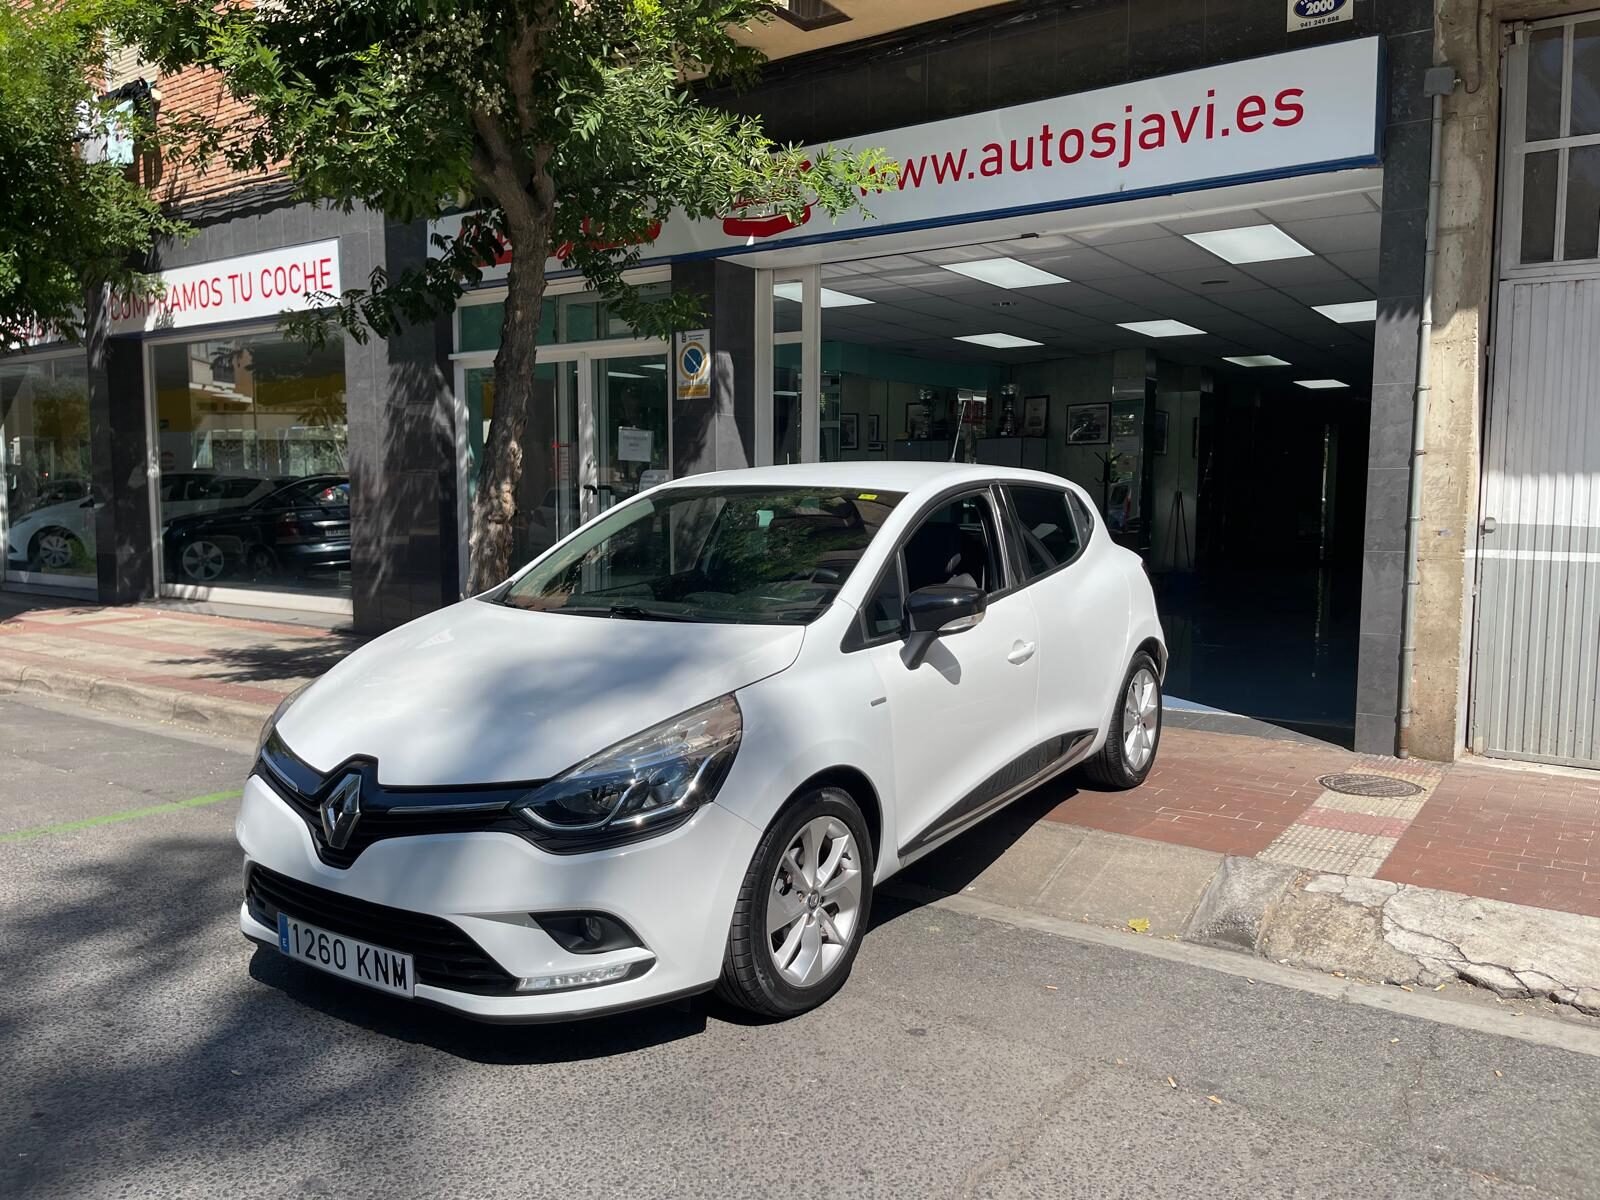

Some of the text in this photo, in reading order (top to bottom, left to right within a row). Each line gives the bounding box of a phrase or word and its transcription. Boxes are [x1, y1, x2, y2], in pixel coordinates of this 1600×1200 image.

[1305, 0, 1335, 15] 2000
[109, 257, 333, 321] COMPRAMOS TU COCHE
[292, 923, 408, 990] 1260 KNM
